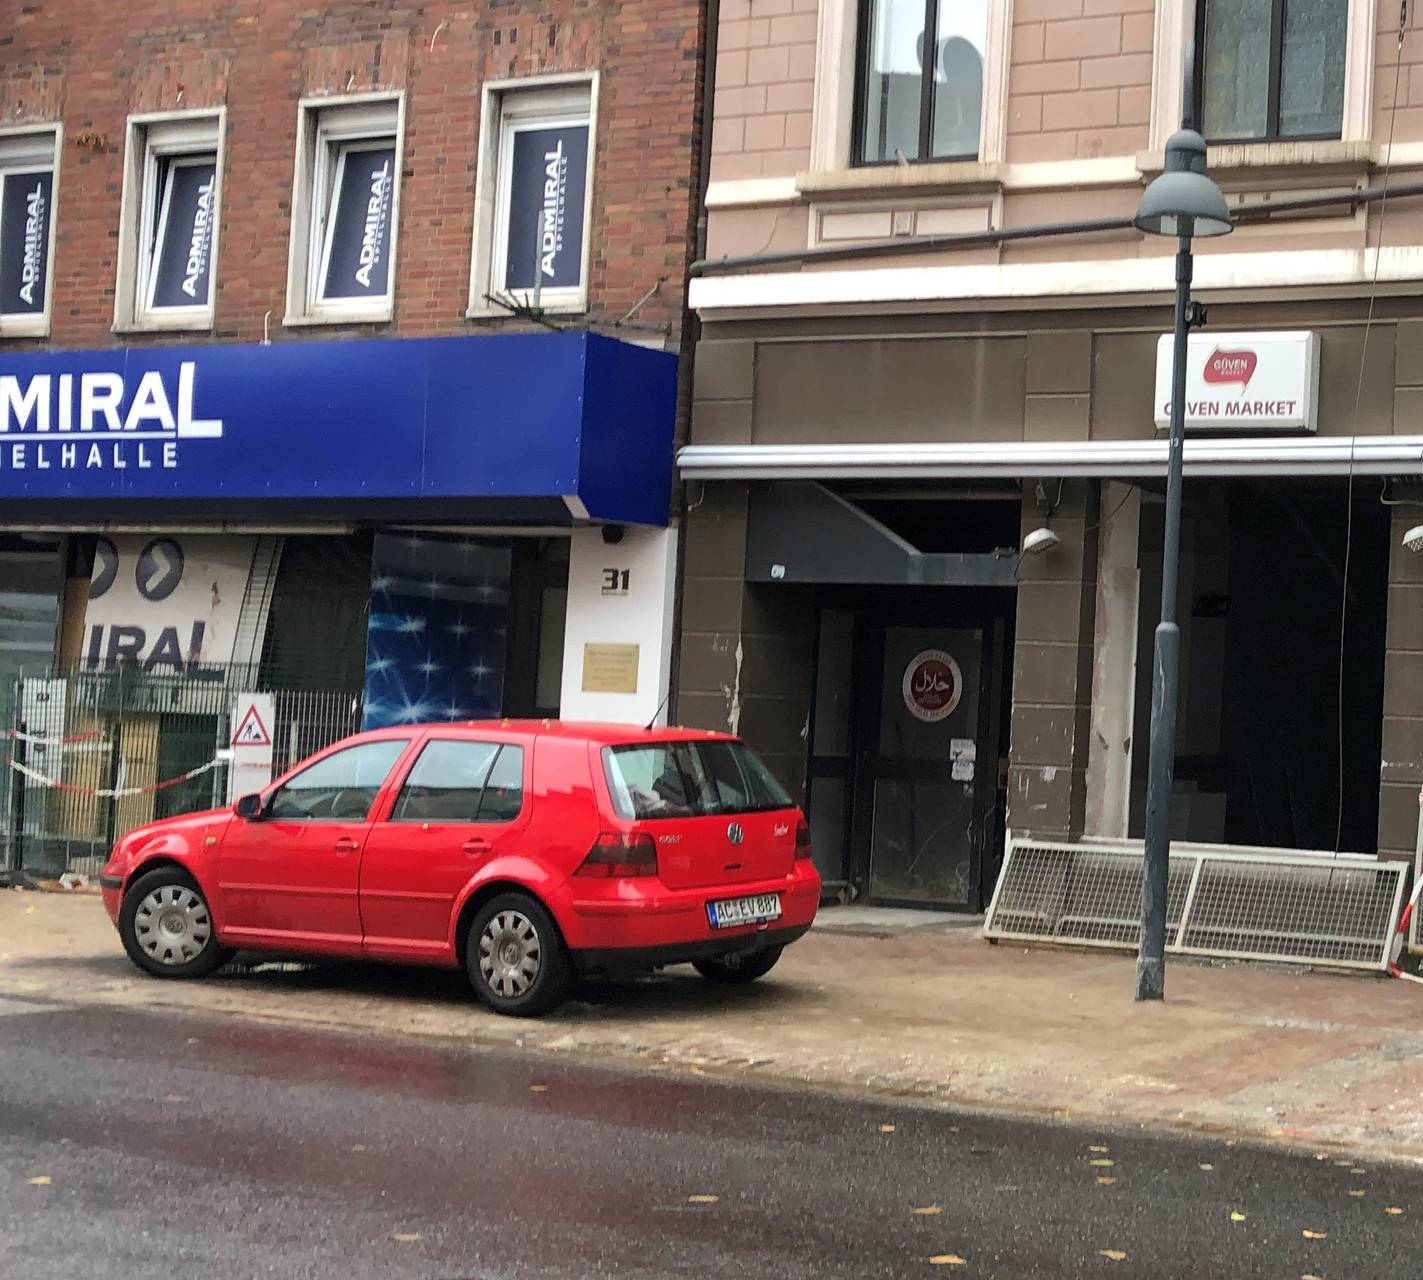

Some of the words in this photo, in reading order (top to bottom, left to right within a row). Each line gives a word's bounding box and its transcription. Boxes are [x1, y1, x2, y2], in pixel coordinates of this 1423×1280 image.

[20, 182, 42, 305] ADMIRAL
[182, 174, 215, 298] ADMIRAL
[355, 159, 389, 288] ADMIRAL
[541, 139, 563, 278] ADMIRAL
[555, 156, 568, 251] SPIELHALLE
[0, 361, 223, 438] MIRAL
[1213, 358, 1248, 371] GÜVEN
[1225, 400, 1297, 416] MARKET
[602, 568, 630, 590] 31
[717, 902, 733, 920] AC
[740, 898, 756, 917] EV
[758, 895, 777, 913] 887
